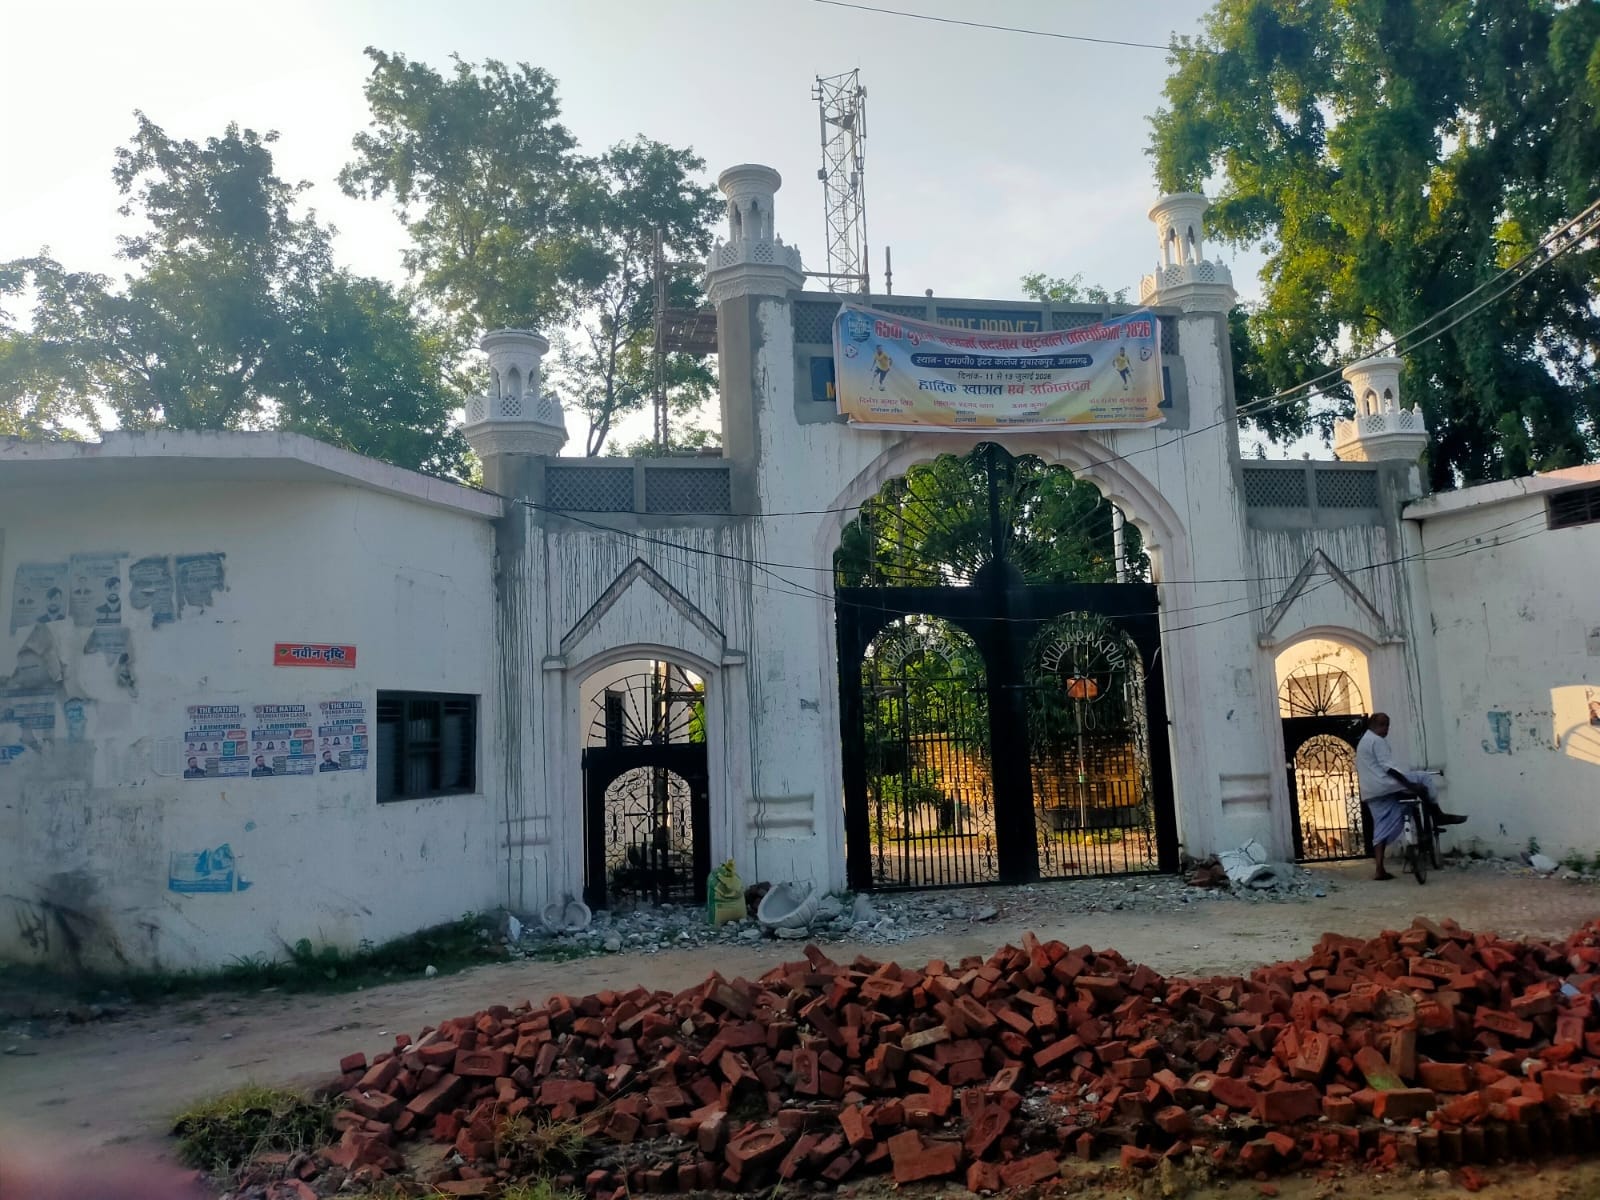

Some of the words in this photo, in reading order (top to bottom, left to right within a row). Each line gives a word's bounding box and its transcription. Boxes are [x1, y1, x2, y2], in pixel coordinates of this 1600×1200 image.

[918, 379, 957, 393] हार्दिक
[962, 384, 1003, 395] स्वागत
[291, 646, 321, 660] नवीन
[323, 647, 345, 661] दृष्टि
